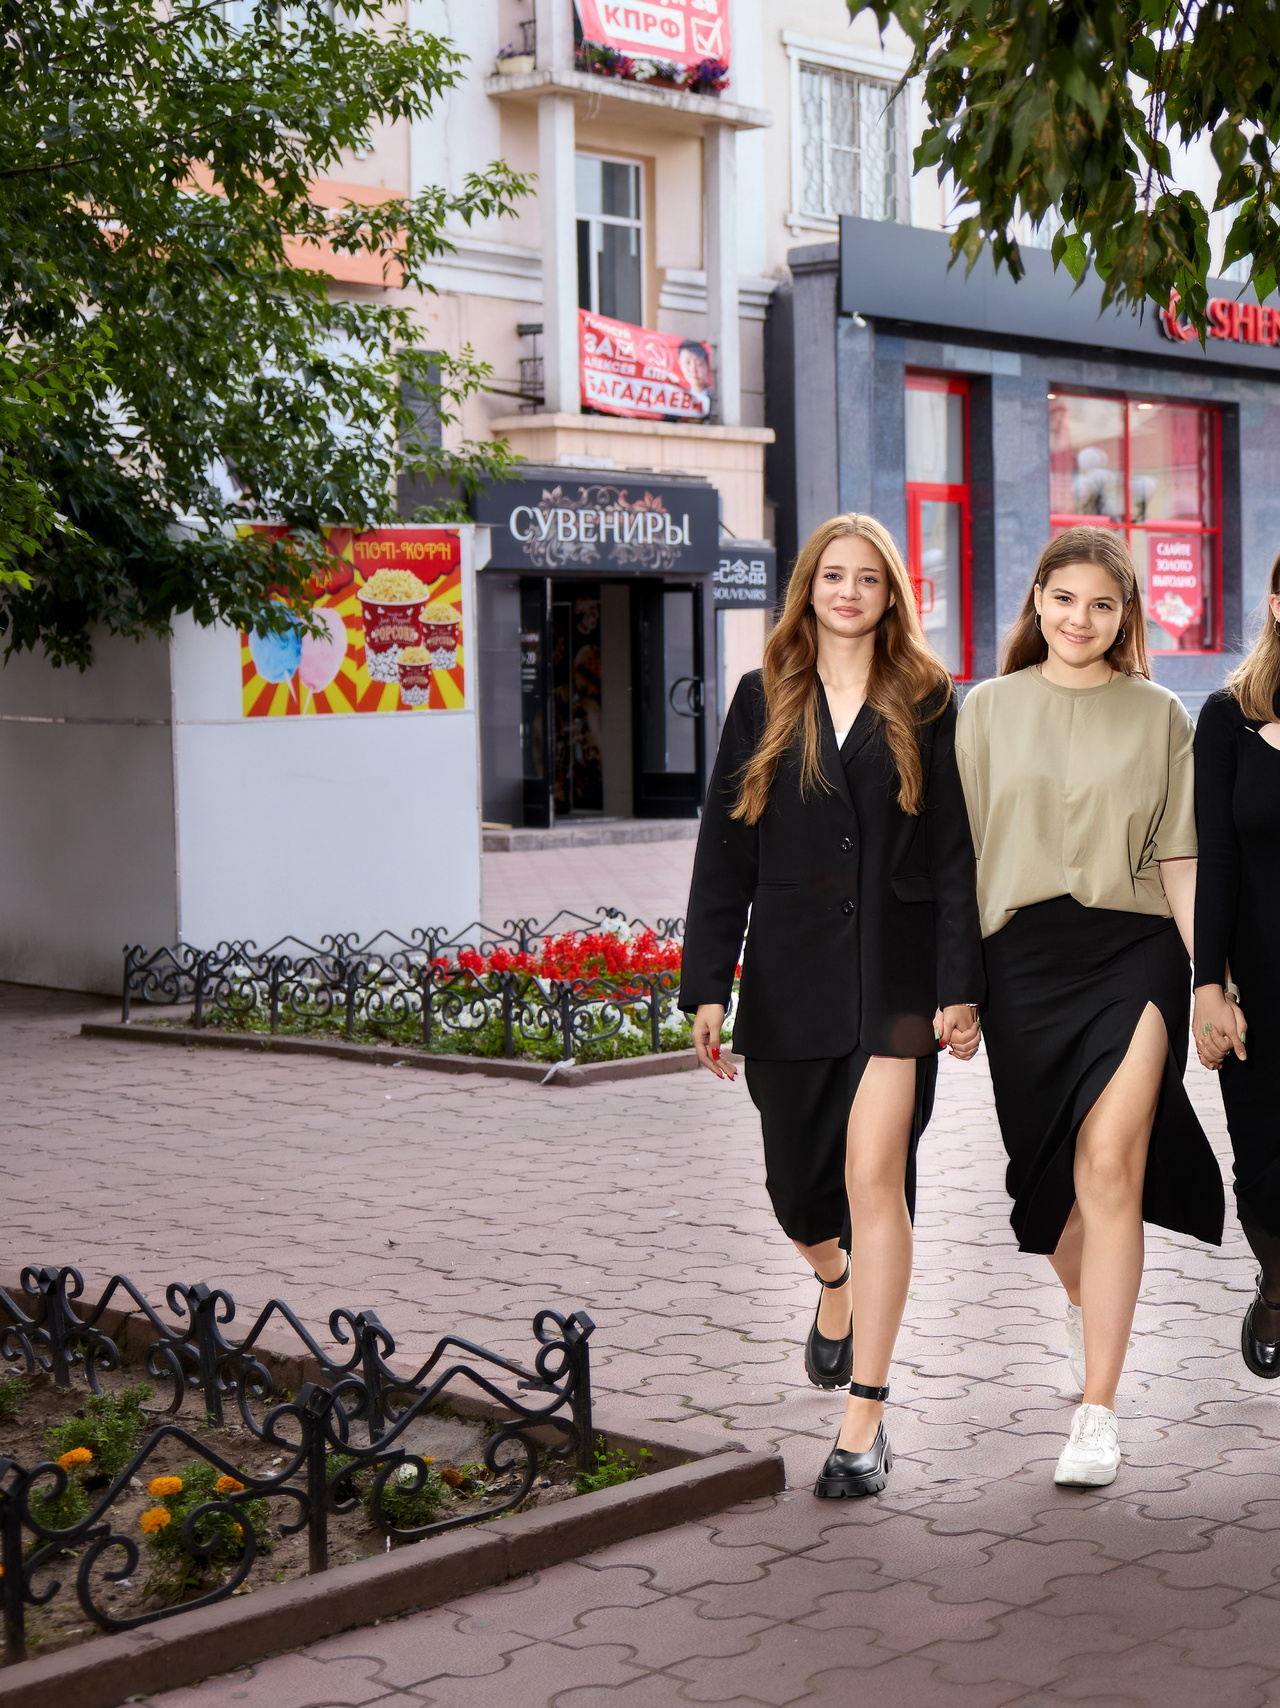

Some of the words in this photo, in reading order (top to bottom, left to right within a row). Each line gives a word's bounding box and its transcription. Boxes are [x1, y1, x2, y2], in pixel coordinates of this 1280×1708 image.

[604, 4, 680, 38] КПРФ
[584, 333, 613, 358] ЗА
[584, 356, 636, 376] АЛЕКСЕЯ
[509, 505, 692, 546] СУВЕНИРЫ
[354, 541, 451, 561] ПОП-КОРН
[1156, 558, 1193, 573] ЗОЛОТО
[374, 625, 415, 643] POPCORN
